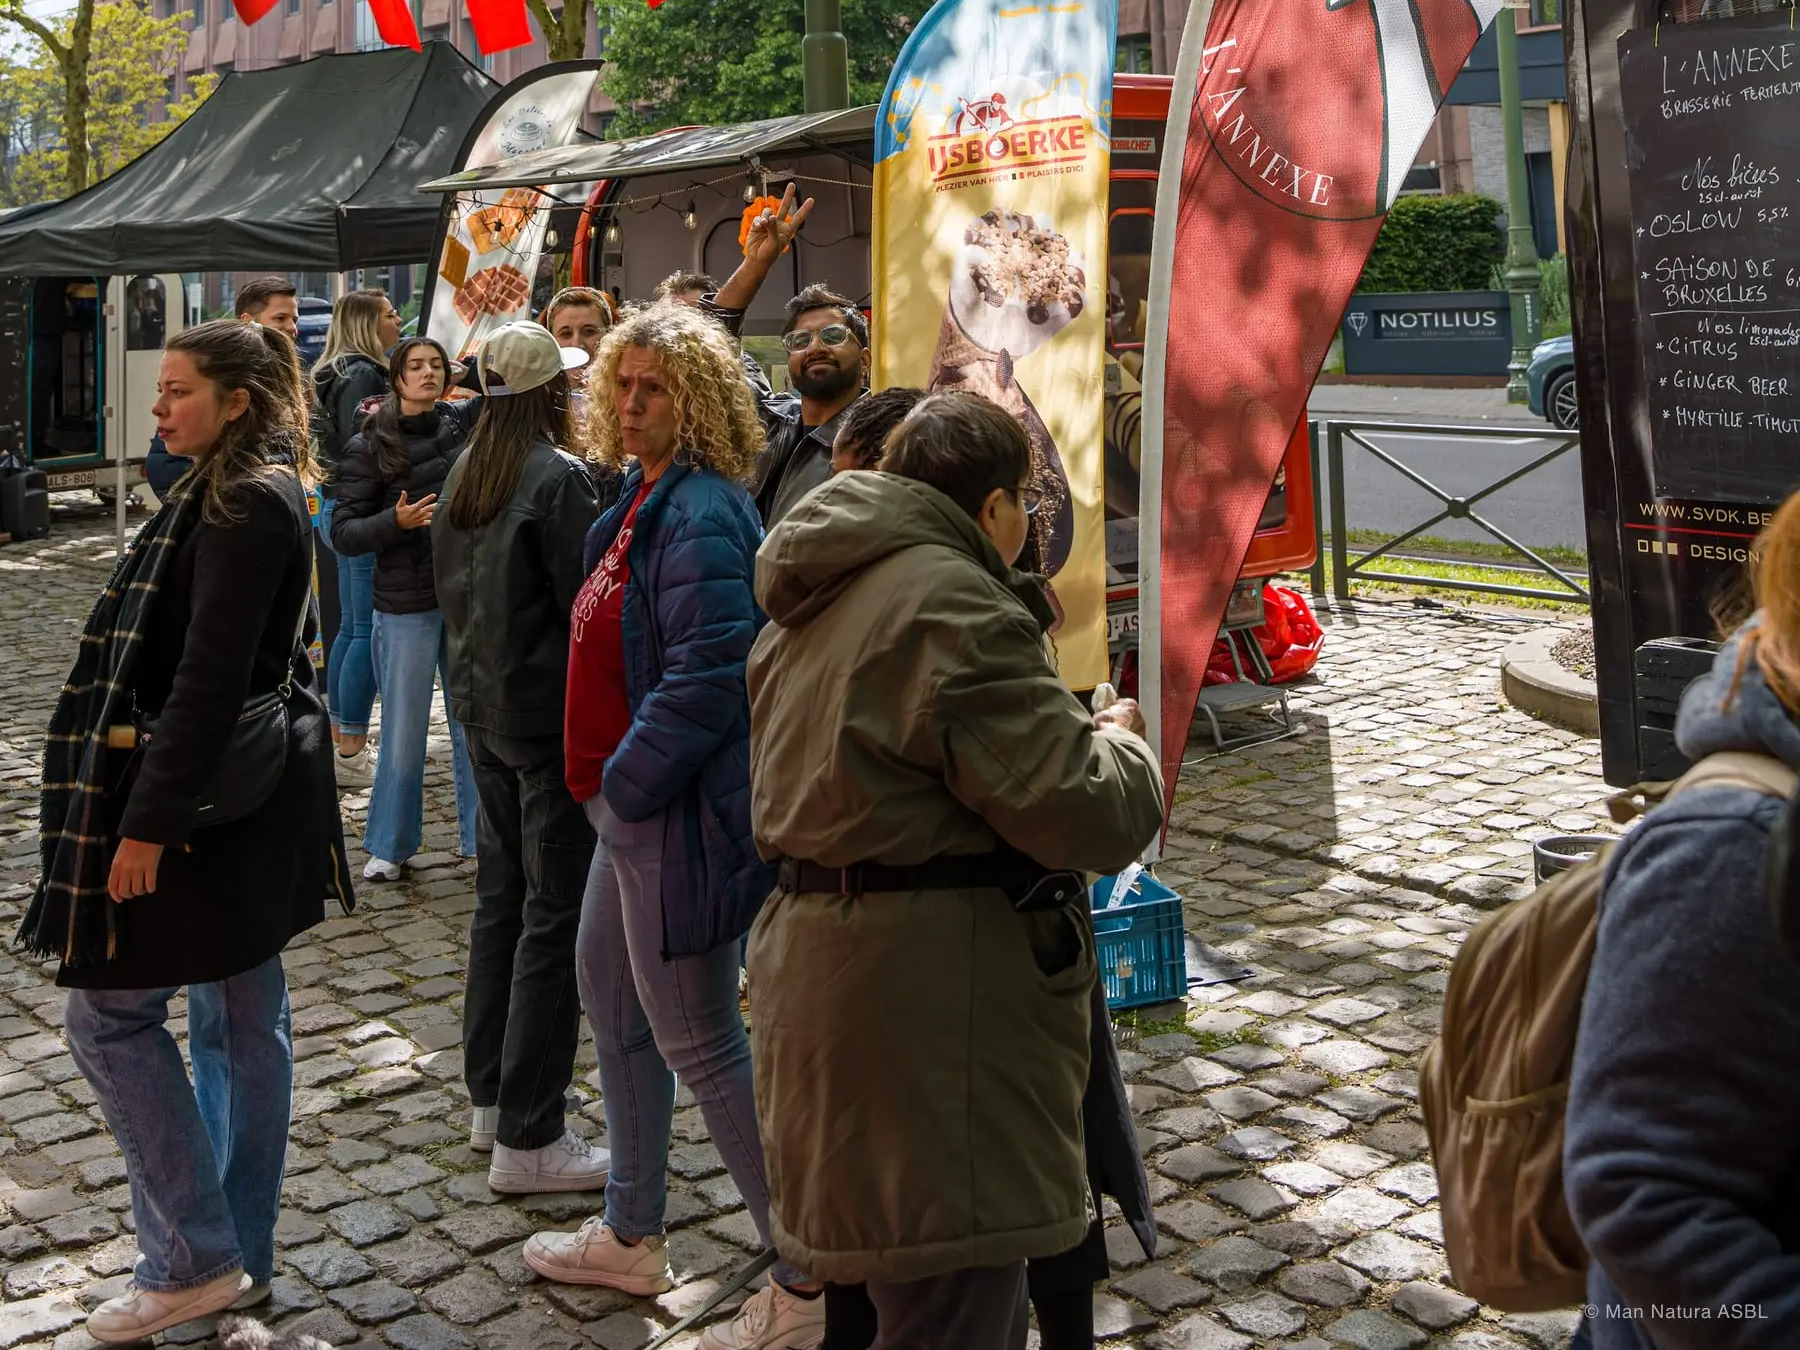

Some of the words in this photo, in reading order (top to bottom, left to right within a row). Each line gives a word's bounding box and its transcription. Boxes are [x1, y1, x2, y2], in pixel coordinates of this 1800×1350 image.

[1663, 43, 1795, 94] L'ANNEXE
[1202, 34, 1333, 206] L'ANNEXE
[928, 125, 1086, 175] IJSBOERKE
[935, 181, 968, 193] PLEZIER
[970, 177, 987, 187] VAN
[1027, 167, 1065, 179] PLAISIRS
[1681, 156, 1720, 190] Nos
[1650, 207, 1742, 237] OSLOW
[1745, 258, 1776, 279] DE
[1662, 283, 1768, 307] BRUXELLES
[1380, 311, 1496, 328] NOTILIUS
[1639, 503, 1773, 527] WWW.SVDK.BE
[1690, 544, 1760, 563] DESIGN
